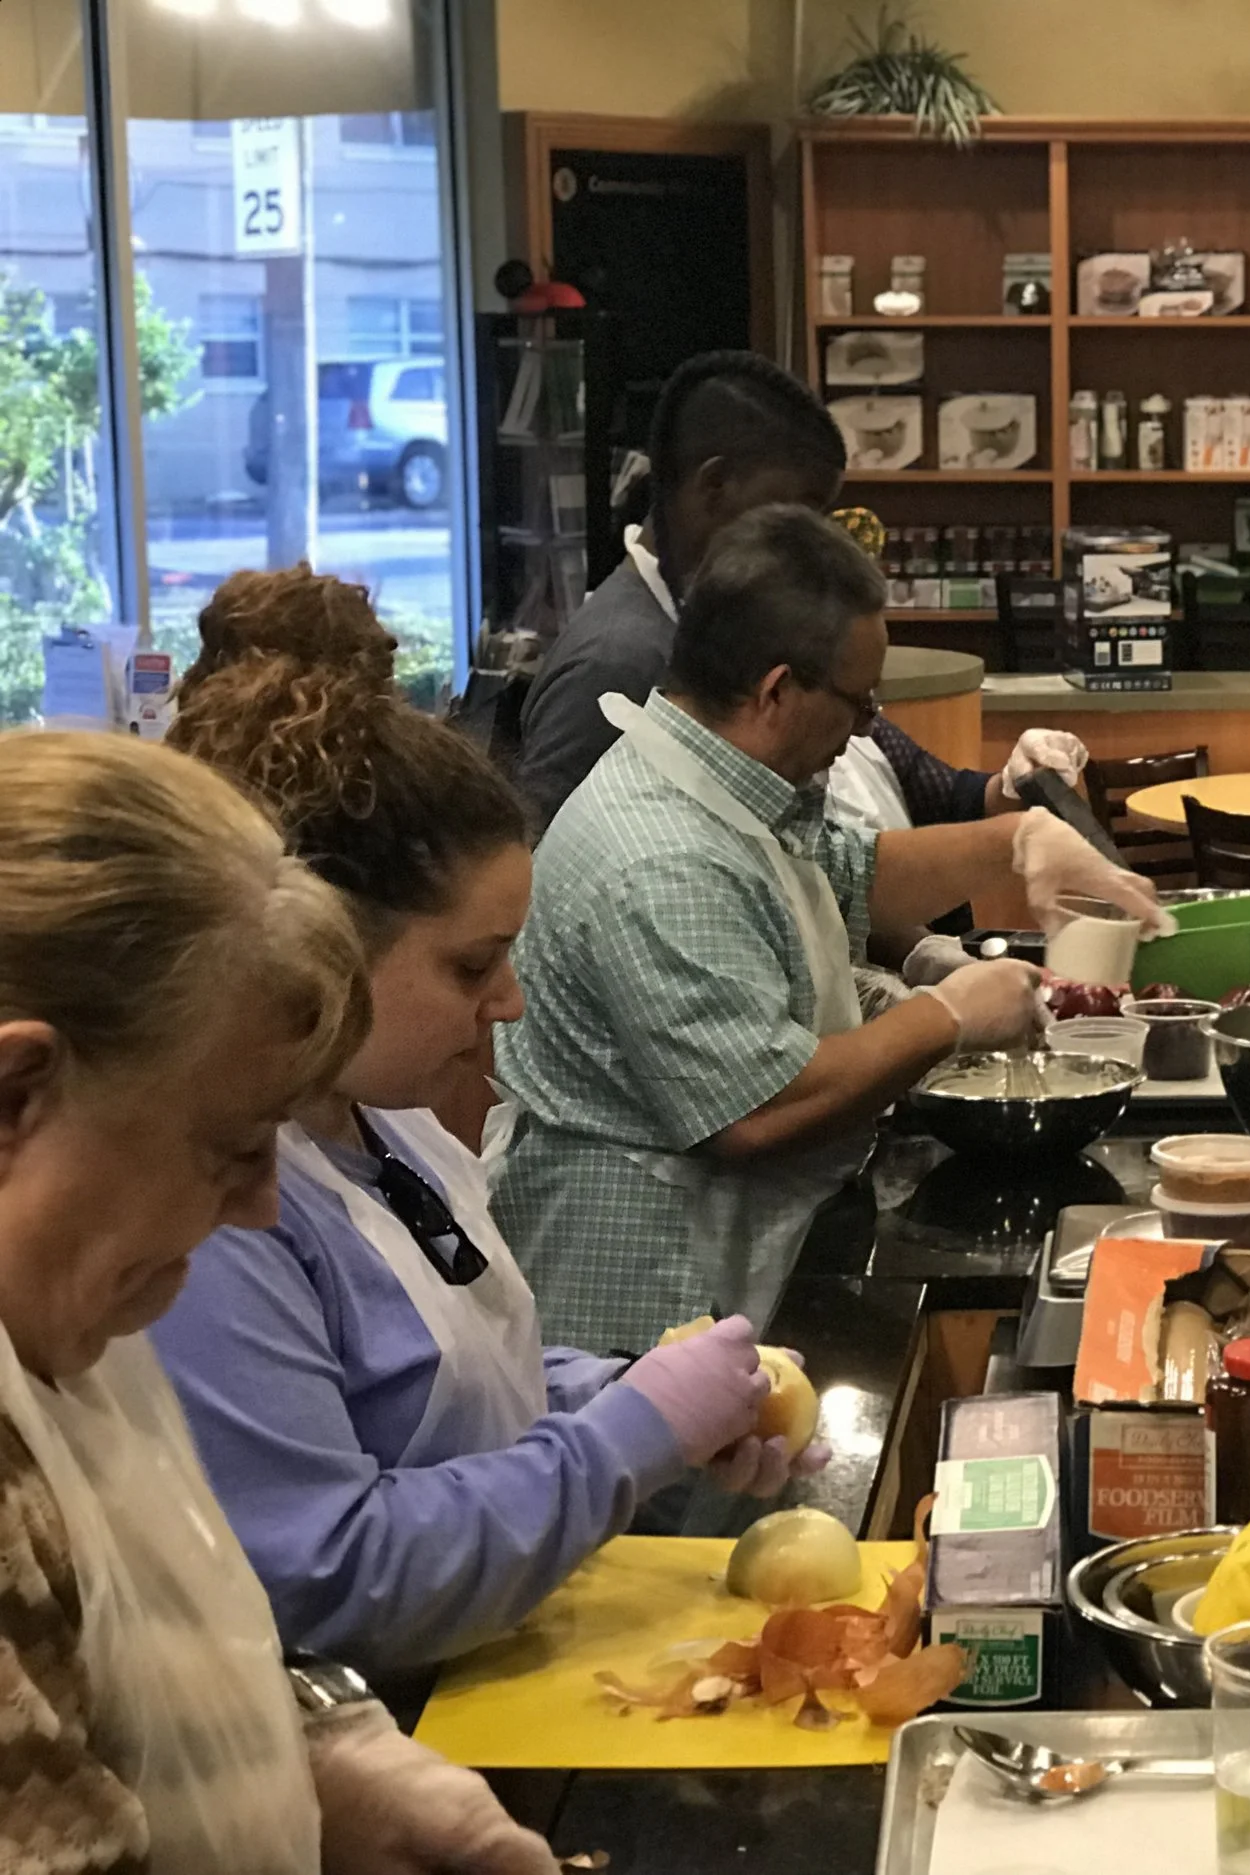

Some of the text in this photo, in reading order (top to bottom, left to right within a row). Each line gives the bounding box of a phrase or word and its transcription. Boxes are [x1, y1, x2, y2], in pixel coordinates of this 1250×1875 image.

[243, 188, 284, 235] 25
[1096, 1487, 1205, 1507] FOODSERV
[1143, 1507, 1198, 1526] FILM
